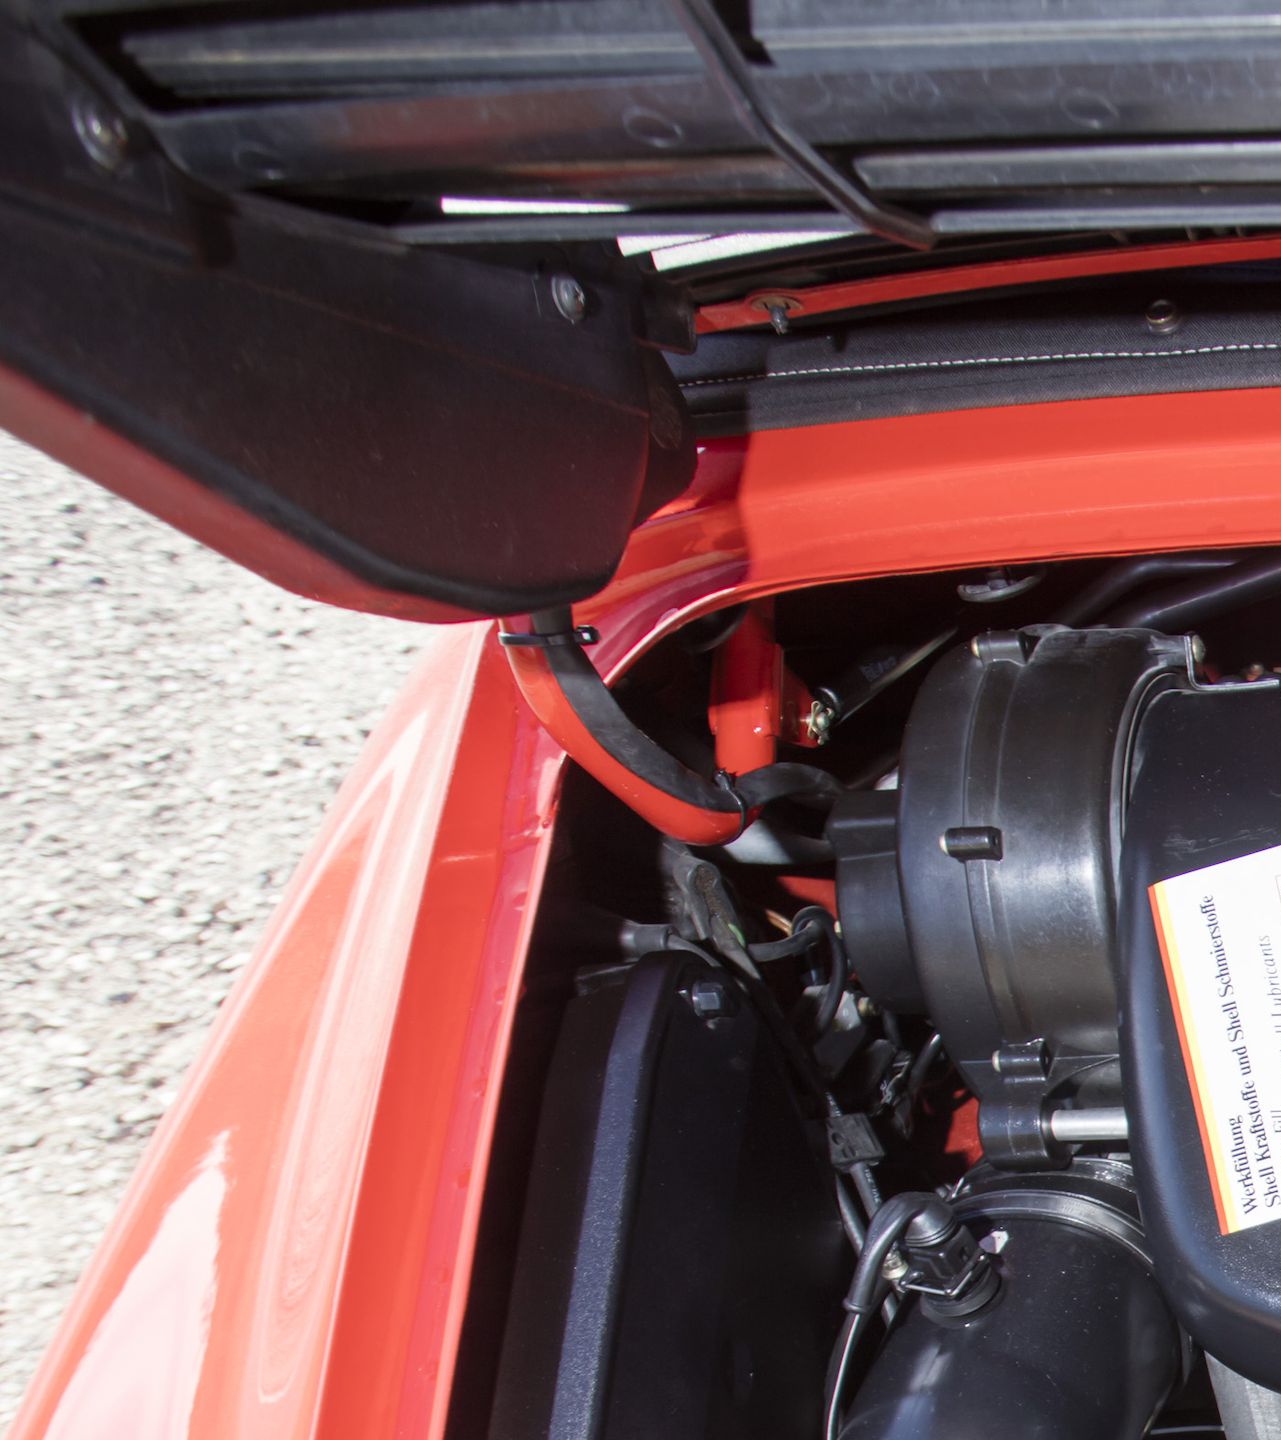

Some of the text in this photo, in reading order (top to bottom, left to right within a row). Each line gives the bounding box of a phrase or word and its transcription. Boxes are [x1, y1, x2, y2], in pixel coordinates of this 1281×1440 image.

[1200, 896, 1281, 1208] Shell Kraftstoffe und Shell Schmierstoffe
[1229, 1115, 1258, 1215] Werkfüllung
